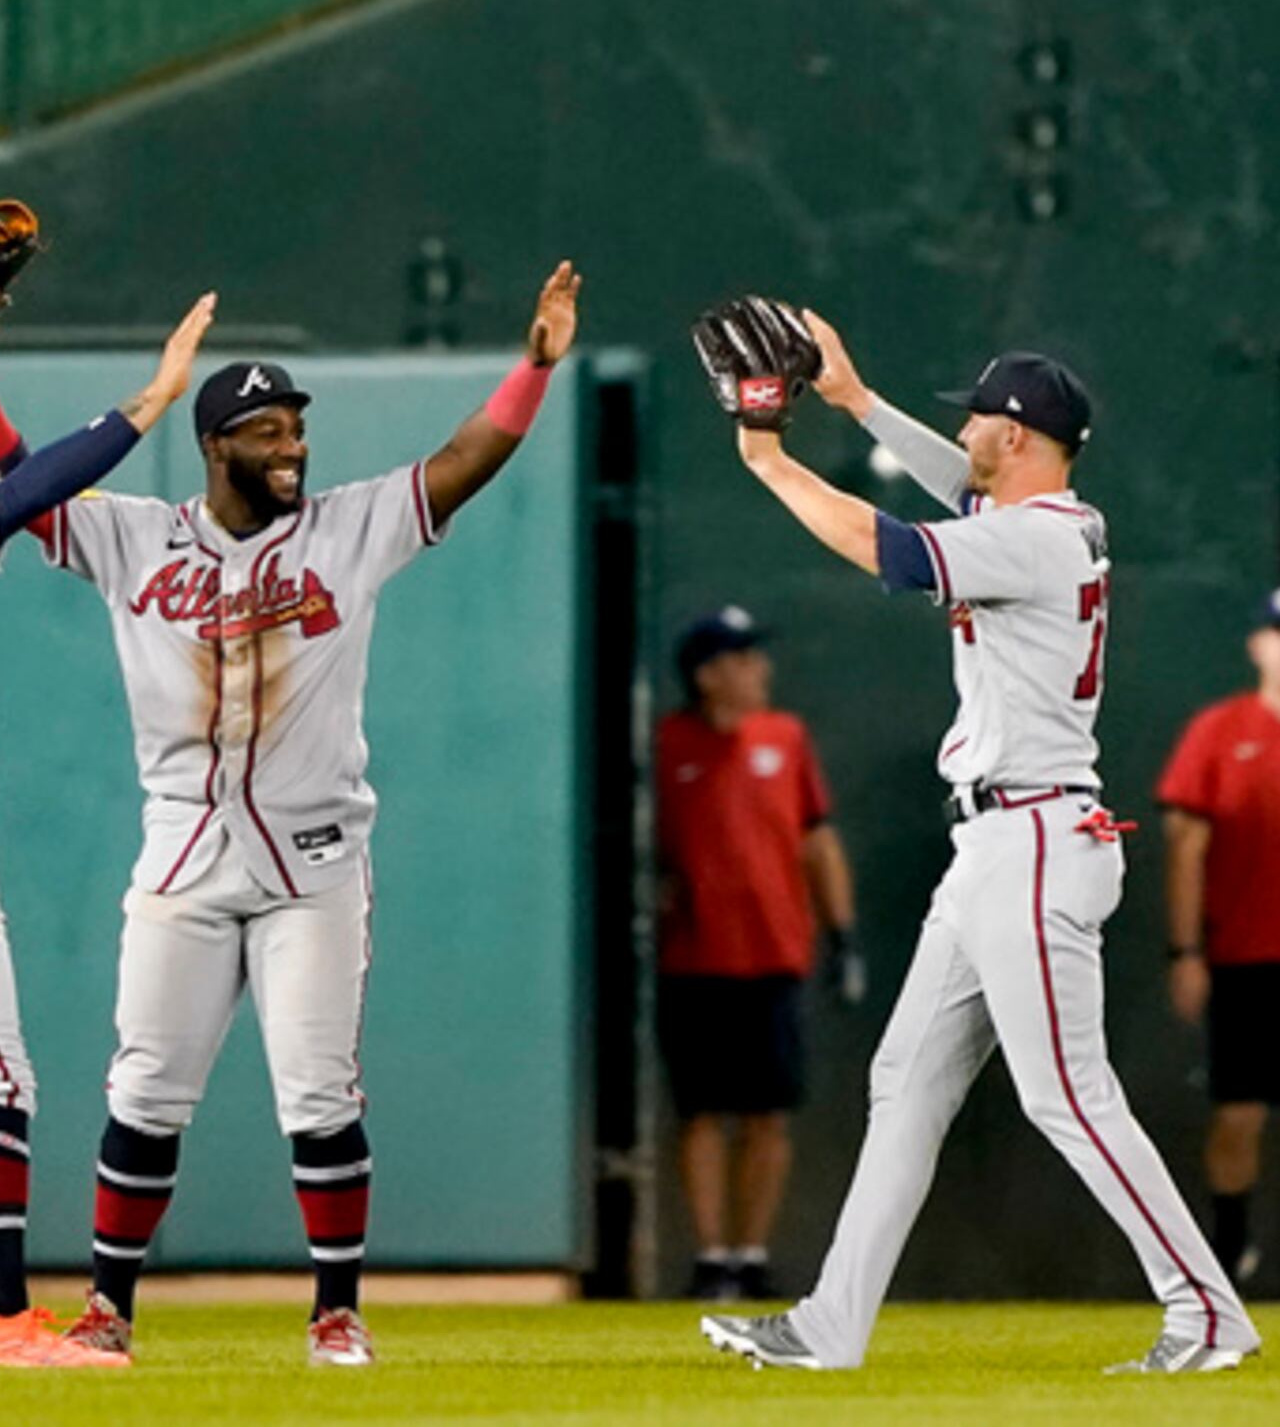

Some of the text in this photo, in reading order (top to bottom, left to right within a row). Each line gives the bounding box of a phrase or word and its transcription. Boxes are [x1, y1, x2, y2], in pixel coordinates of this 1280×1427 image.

[236, 364, 271, 397] A
[128, 551, 304, 622] Atlanta
[1073, 573, 1111, 700] 7
